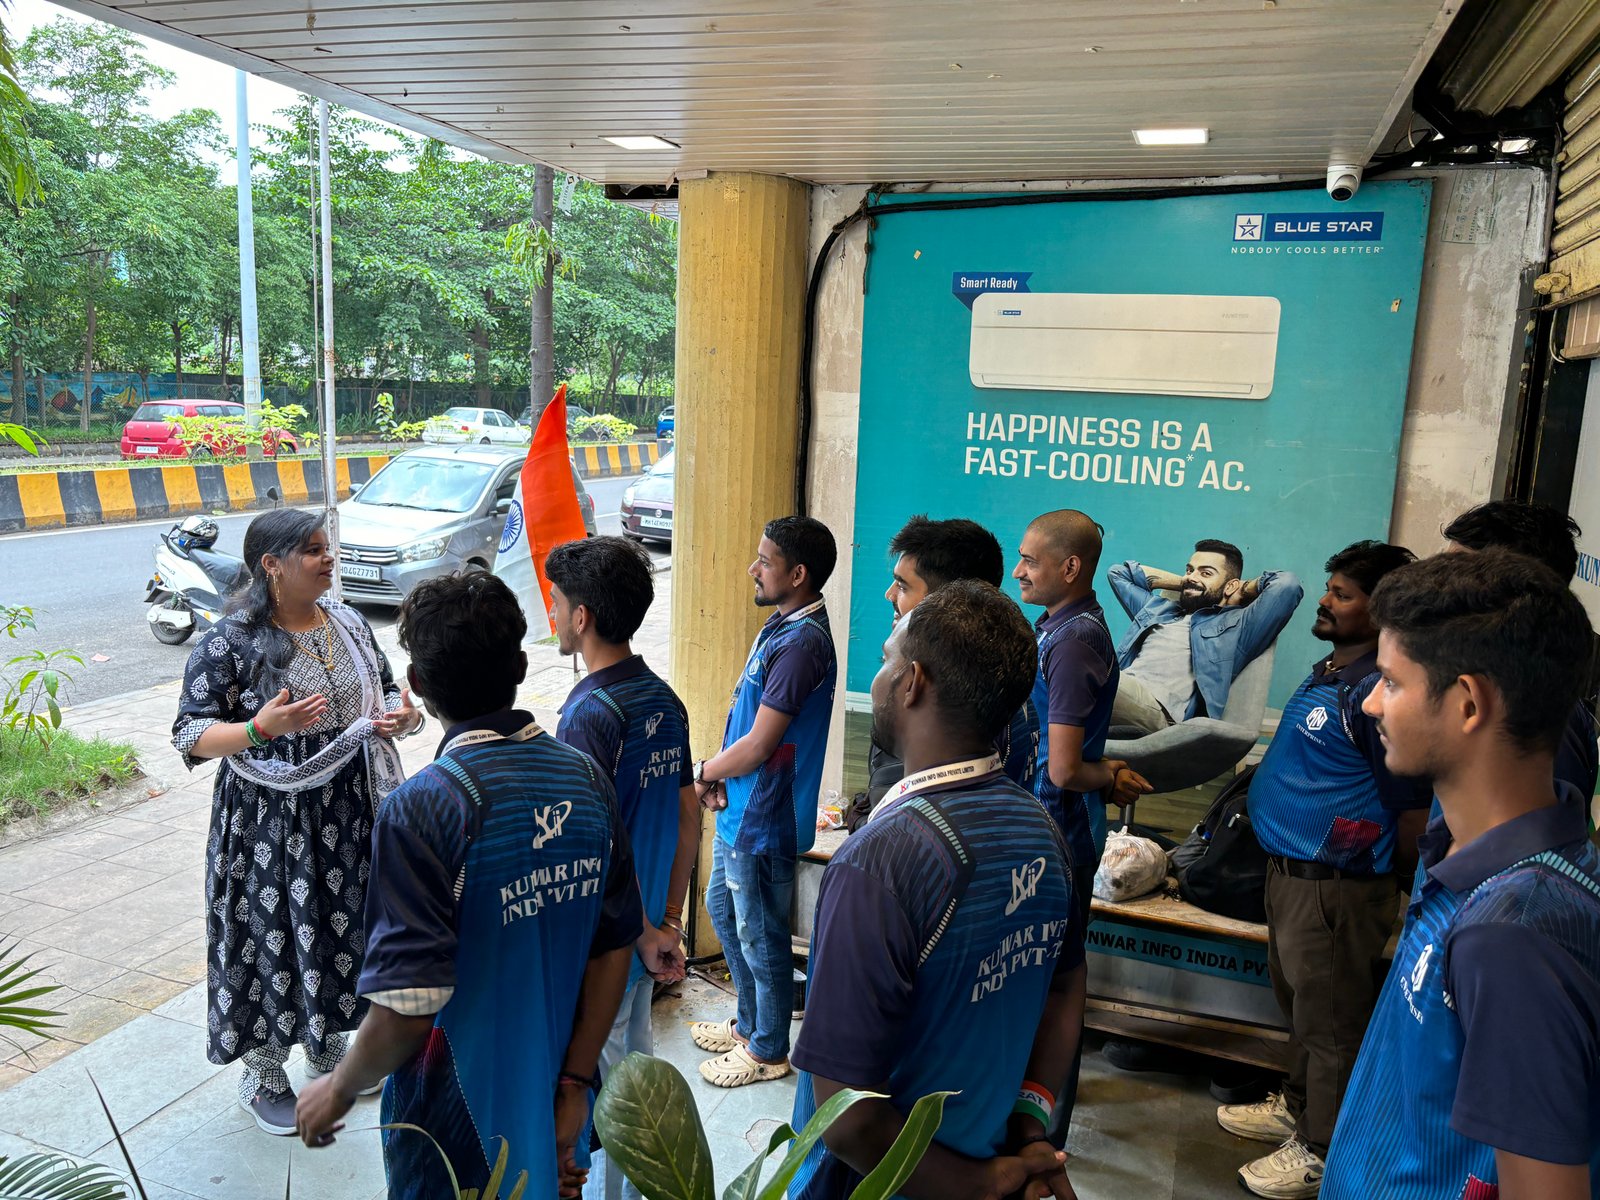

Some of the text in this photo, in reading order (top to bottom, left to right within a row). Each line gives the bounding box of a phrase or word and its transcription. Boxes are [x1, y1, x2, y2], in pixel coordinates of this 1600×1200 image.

[1274, 221, 1373, 233] BLUE STAR
[1231, 246, 1281, 254] NOBODY
[1286, 246, 1327, 254] COOLS
[960, 276, 1018, 291] Smart Ready
[966, 411, 1213, 452] HAPPINESS IS A
[1197, 459, 1251, 492] AC.
[340, 566, 378, 578] H04GZ7731
[1577, 551, 1600, 588] KUN
[937, 771, 947, 780] INDIA
[1010, 946, 1048, 974] PVT
[1088, 930, 1137, 953] NWAR
[1140, 940, 1183, 961] INFO
[1186, 949, 1238, 972] INDIA
